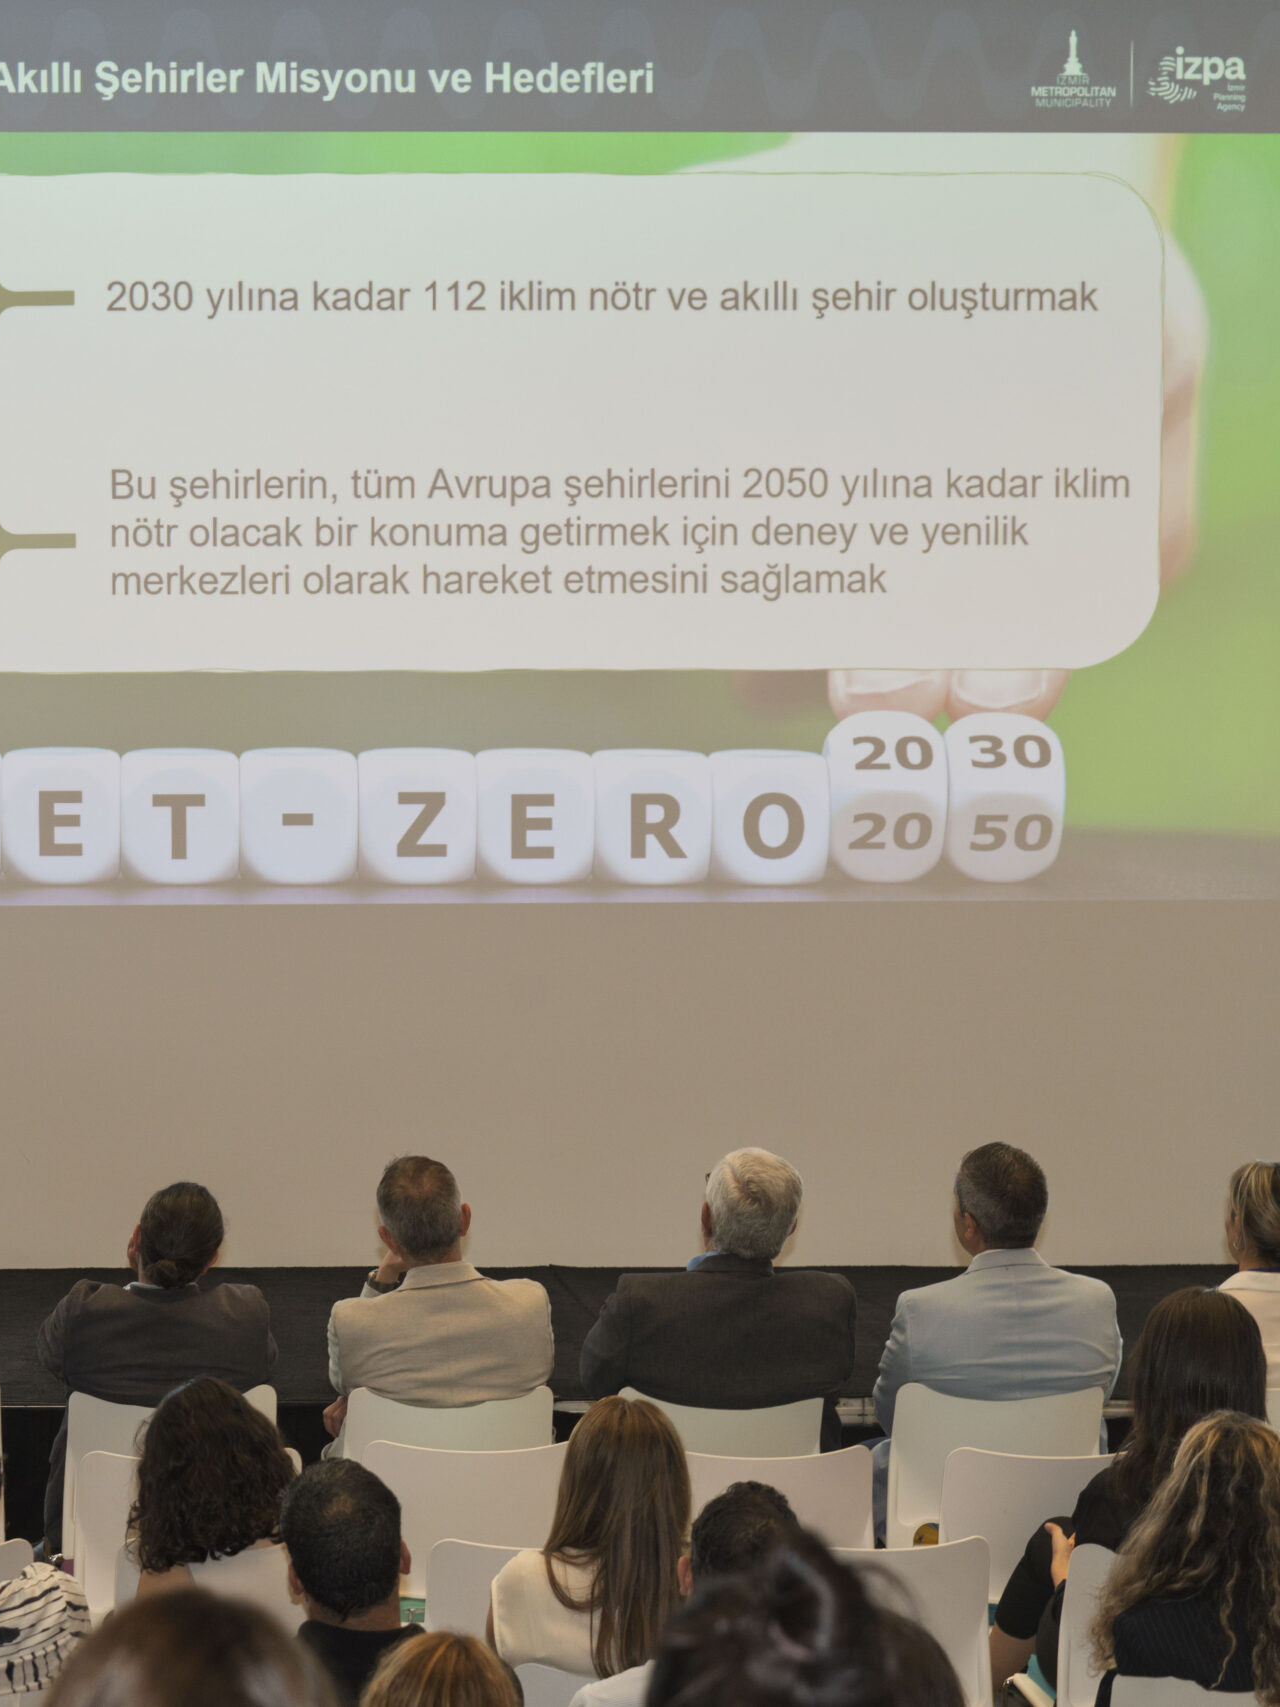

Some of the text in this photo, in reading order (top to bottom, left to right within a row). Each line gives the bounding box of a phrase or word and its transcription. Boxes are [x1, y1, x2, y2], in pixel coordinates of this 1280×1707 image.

[94, 60, 245, 101] Şehirler
[255, 61, 416, 102] Misyonu
[427, 68, 473, 94] ve
[485, 61, 654, 94] Hedefleri
[1175, 46, 1247, 86] izpa
[1031, 86, 1117, 97] METROPOLITAN
[1035, 97, 1112, 108] MUNICIPALITY
[106, 280, 1099, 320] 2030 yılına kadar 112 iklim nötr ve akıllı şehir oluşturmak
[111, 467, 1130, 508] Bu şehirlerin, tüm Avrupa şehirlerini 2050 yılına kadar iklim
[111, 514, 1029, 555] nötr olacak bir konuma getirmek için deney ve yenilik
[111, 562, 888, 602] merkezleri olarak hareket etmesini sağlamak
